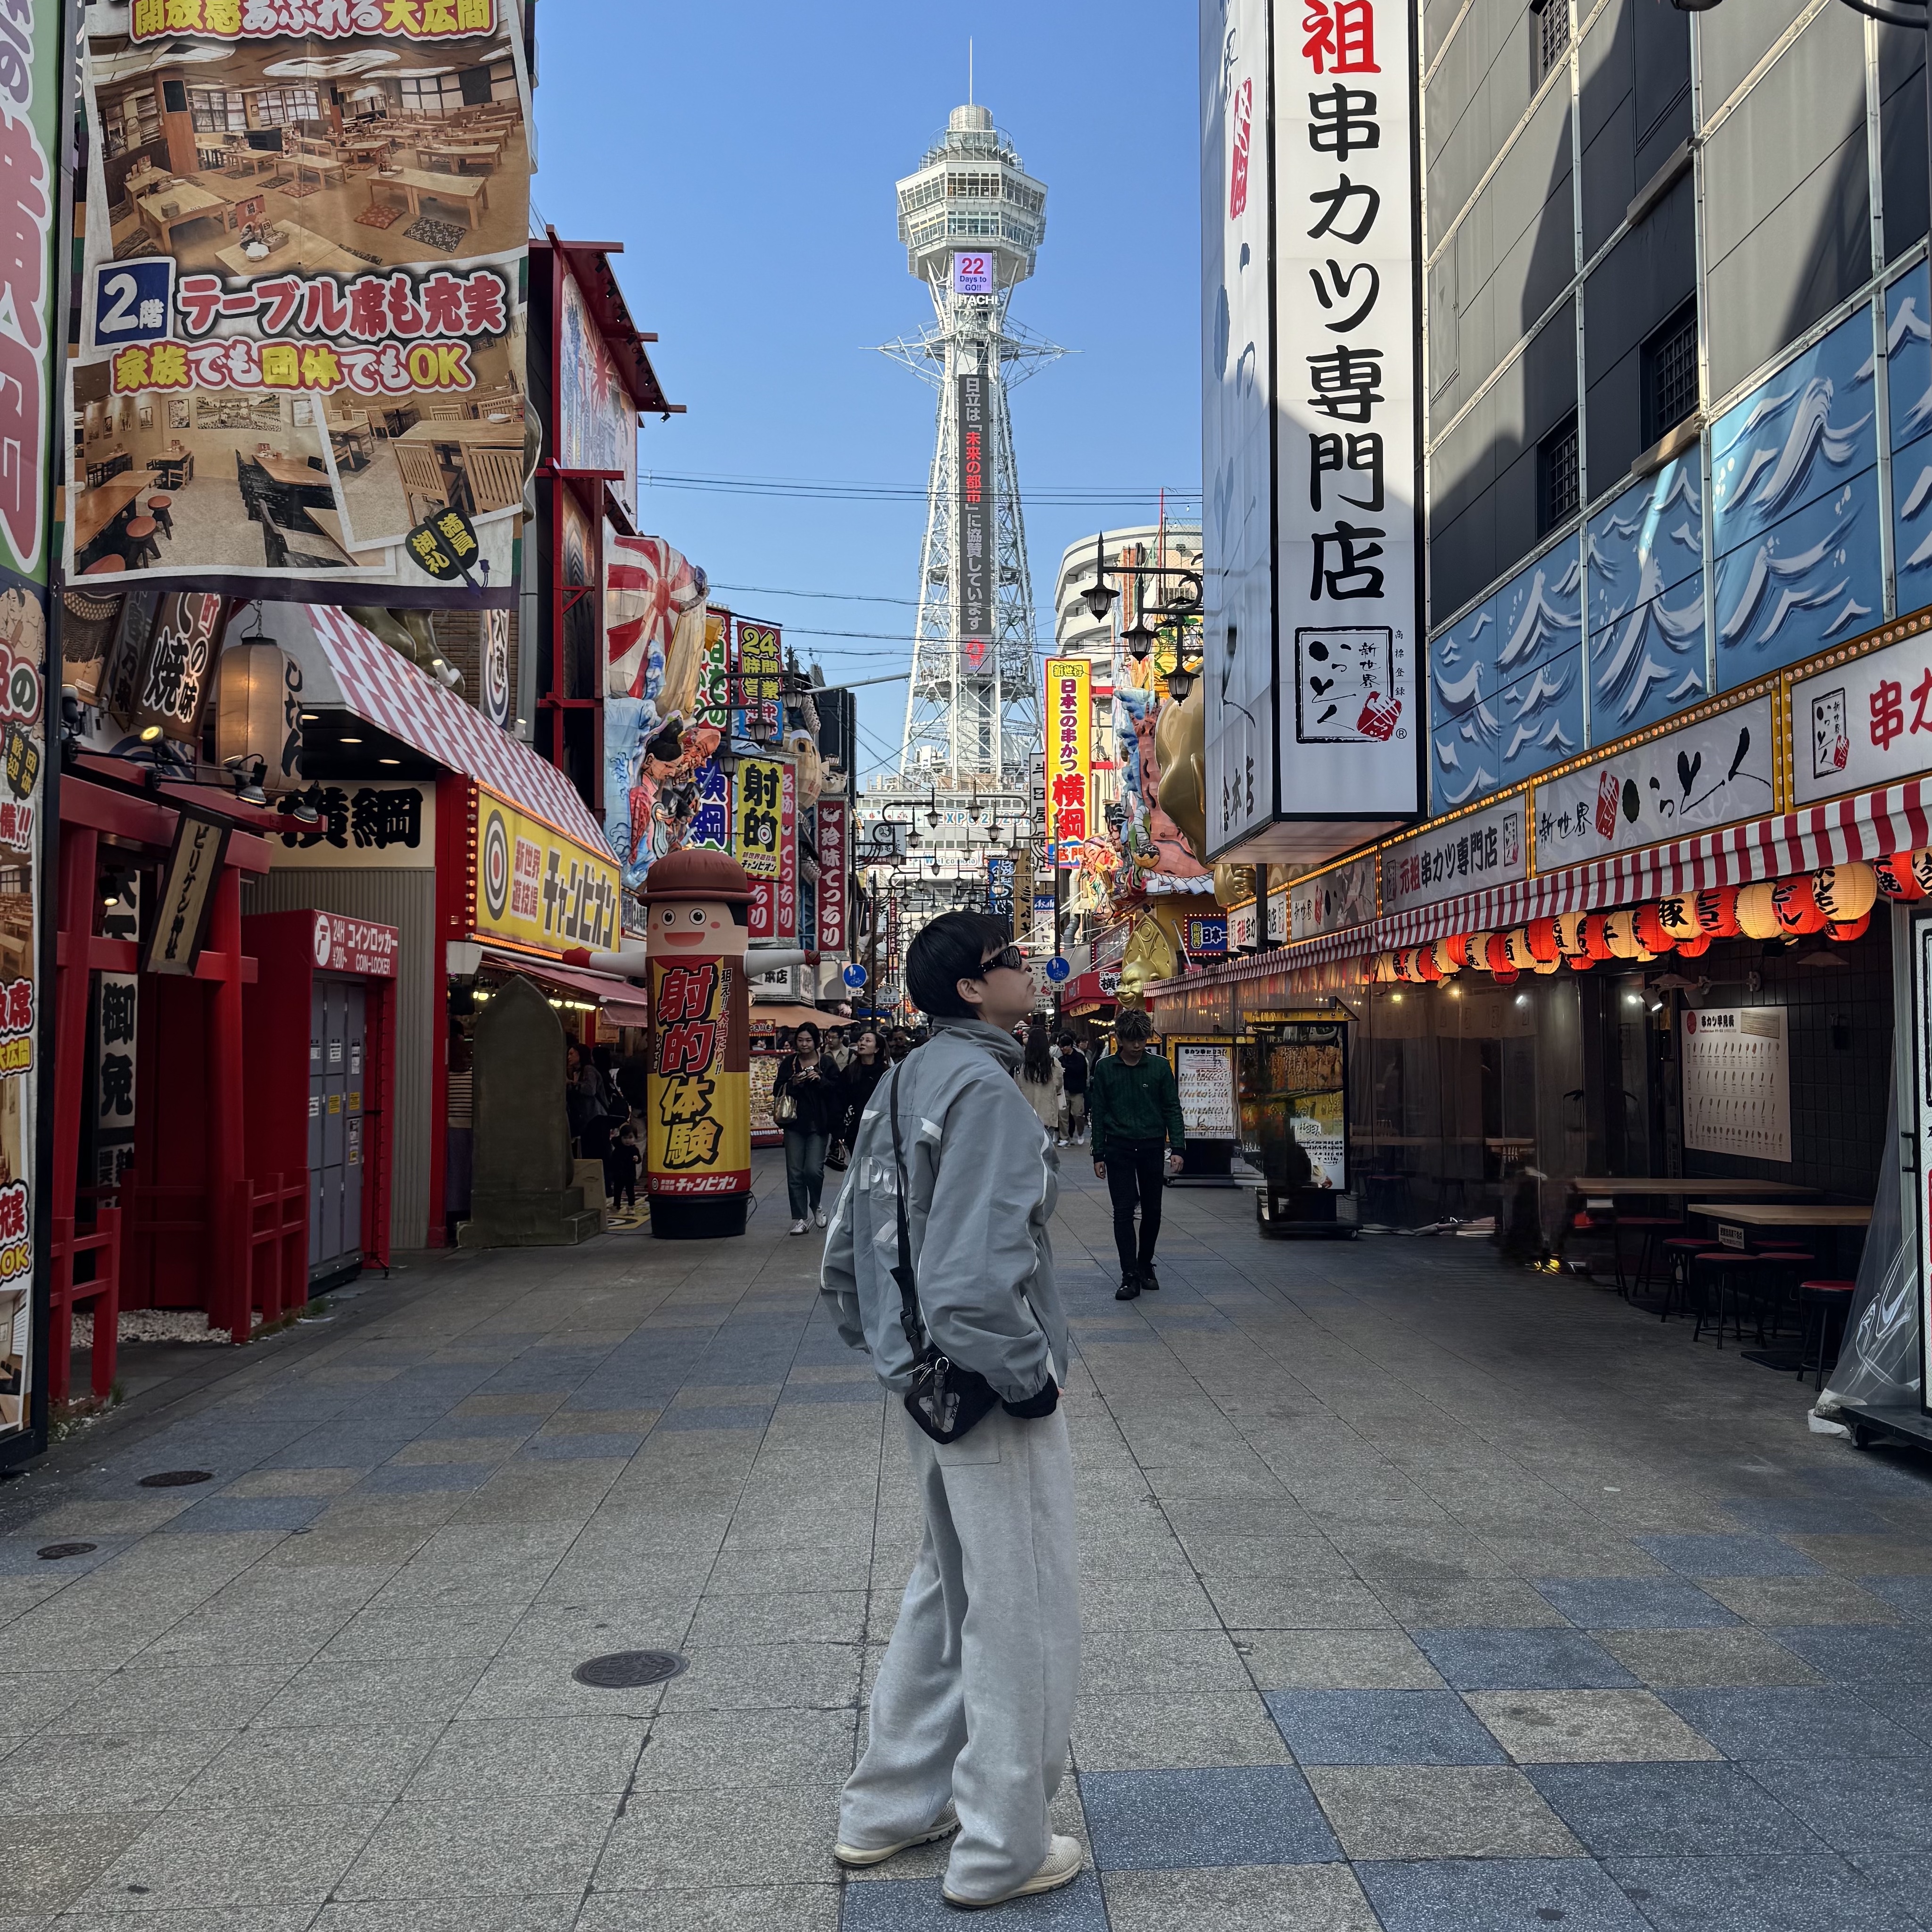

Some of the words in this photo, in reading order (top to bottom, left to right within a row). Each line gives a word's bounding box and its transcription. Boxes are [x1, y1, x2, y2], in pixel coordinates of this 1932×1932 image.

[134, 0, 490, 34] 開放感あふれる大広間
[960, 275, 978, 283] Days
[962, 258, 984, 275] 22
[98, 273, 164, 334] 2階
[180, 273, 504, 338] テーブル席も充実
[949, 295, 998, 305] HITACHI
[115, 340, 468, 390] 家族でも団体でもOK
[965, 377, 983, 631] 日立は「未来の都市」に協賛しています
[412, 530, 450, 574] 御礼
[437, 513, 476, 556] 満員
[742, 627, 779, 658] 24
[1394, 629, 1406, 696] 商標登録
[742, 655, 779, 677] 時間
[1359, 642, 1381, 689] 新世界
[743, 678, 779, 701] 営業
[1060, 679, 1078, 772] 日本一の串かつ
[743, 763, 780, 852] 射的
[1052, 774, 1086, 841] 横綱
[1539, 801, 1592, 845] 新世界
[514, 839, 542, 881] 新世界
[741, 859, 777, 872] チャンピオン
[1399, 826, 1498, 895] 元祖串カツ専門店
[543, 850, 617, 949] チャンピオン
[779, 844, 794, 929] てっちり
[821, 827, 842, 947] 珍味てっちり
[1659, 898, 1689, 928] 豚
[333, 919, 345, 943] 24H
[348, 924, 398, 954] コインロッカー
[356, 953, 390, 974] COIN-LOCKER
[676, 1176, 738, 1191] チャンピオン
